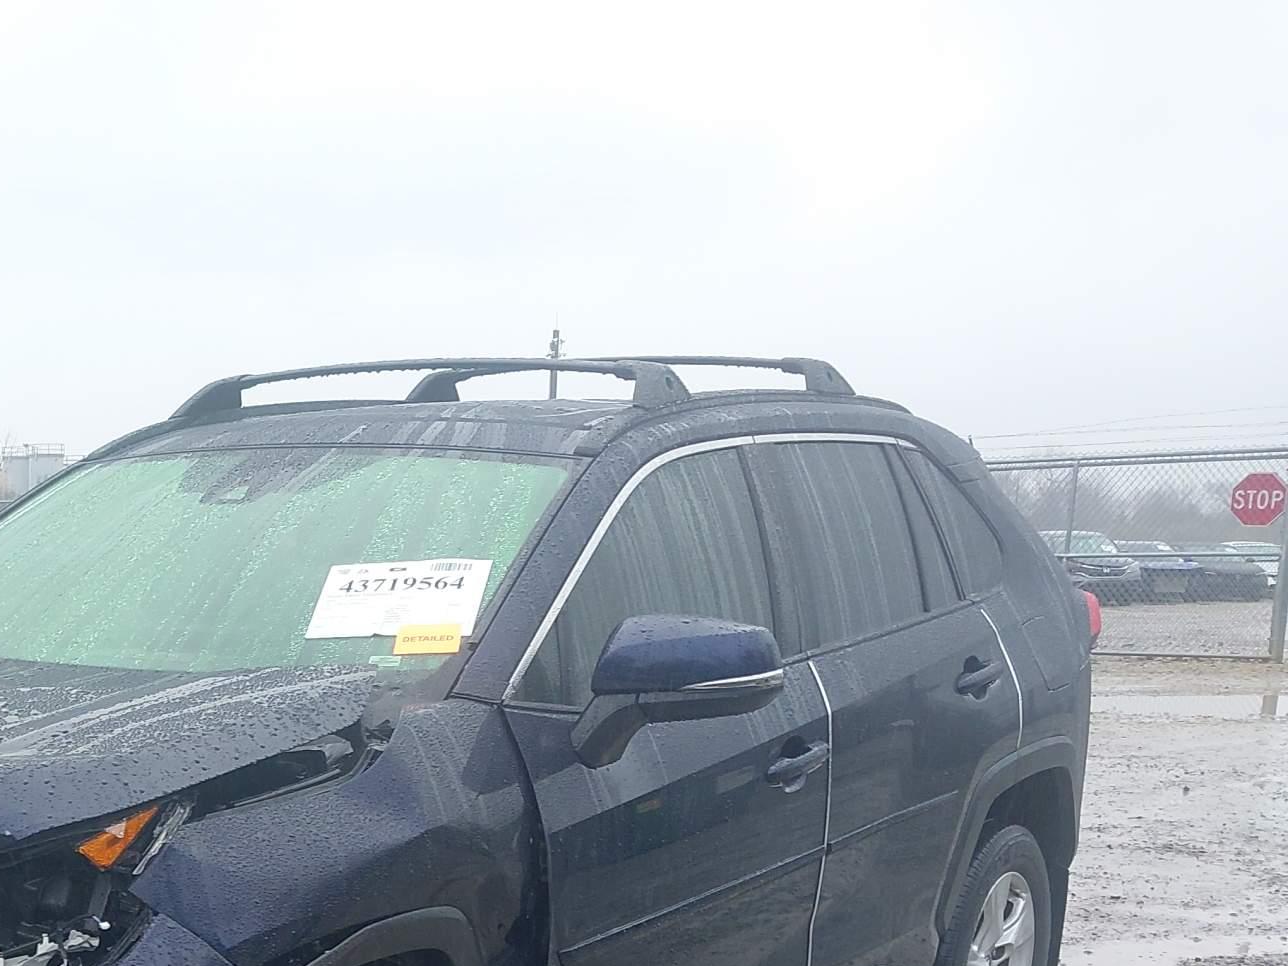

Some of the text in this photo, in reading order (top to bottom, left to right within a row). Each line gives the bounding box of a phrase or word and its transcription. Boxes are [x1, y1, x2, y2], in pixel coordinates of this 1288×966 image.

[1233, 490, 1284, 510] STOP
[339, 576, 465, 593] 43719564
[402, 635, 454, 643] DETAILED
